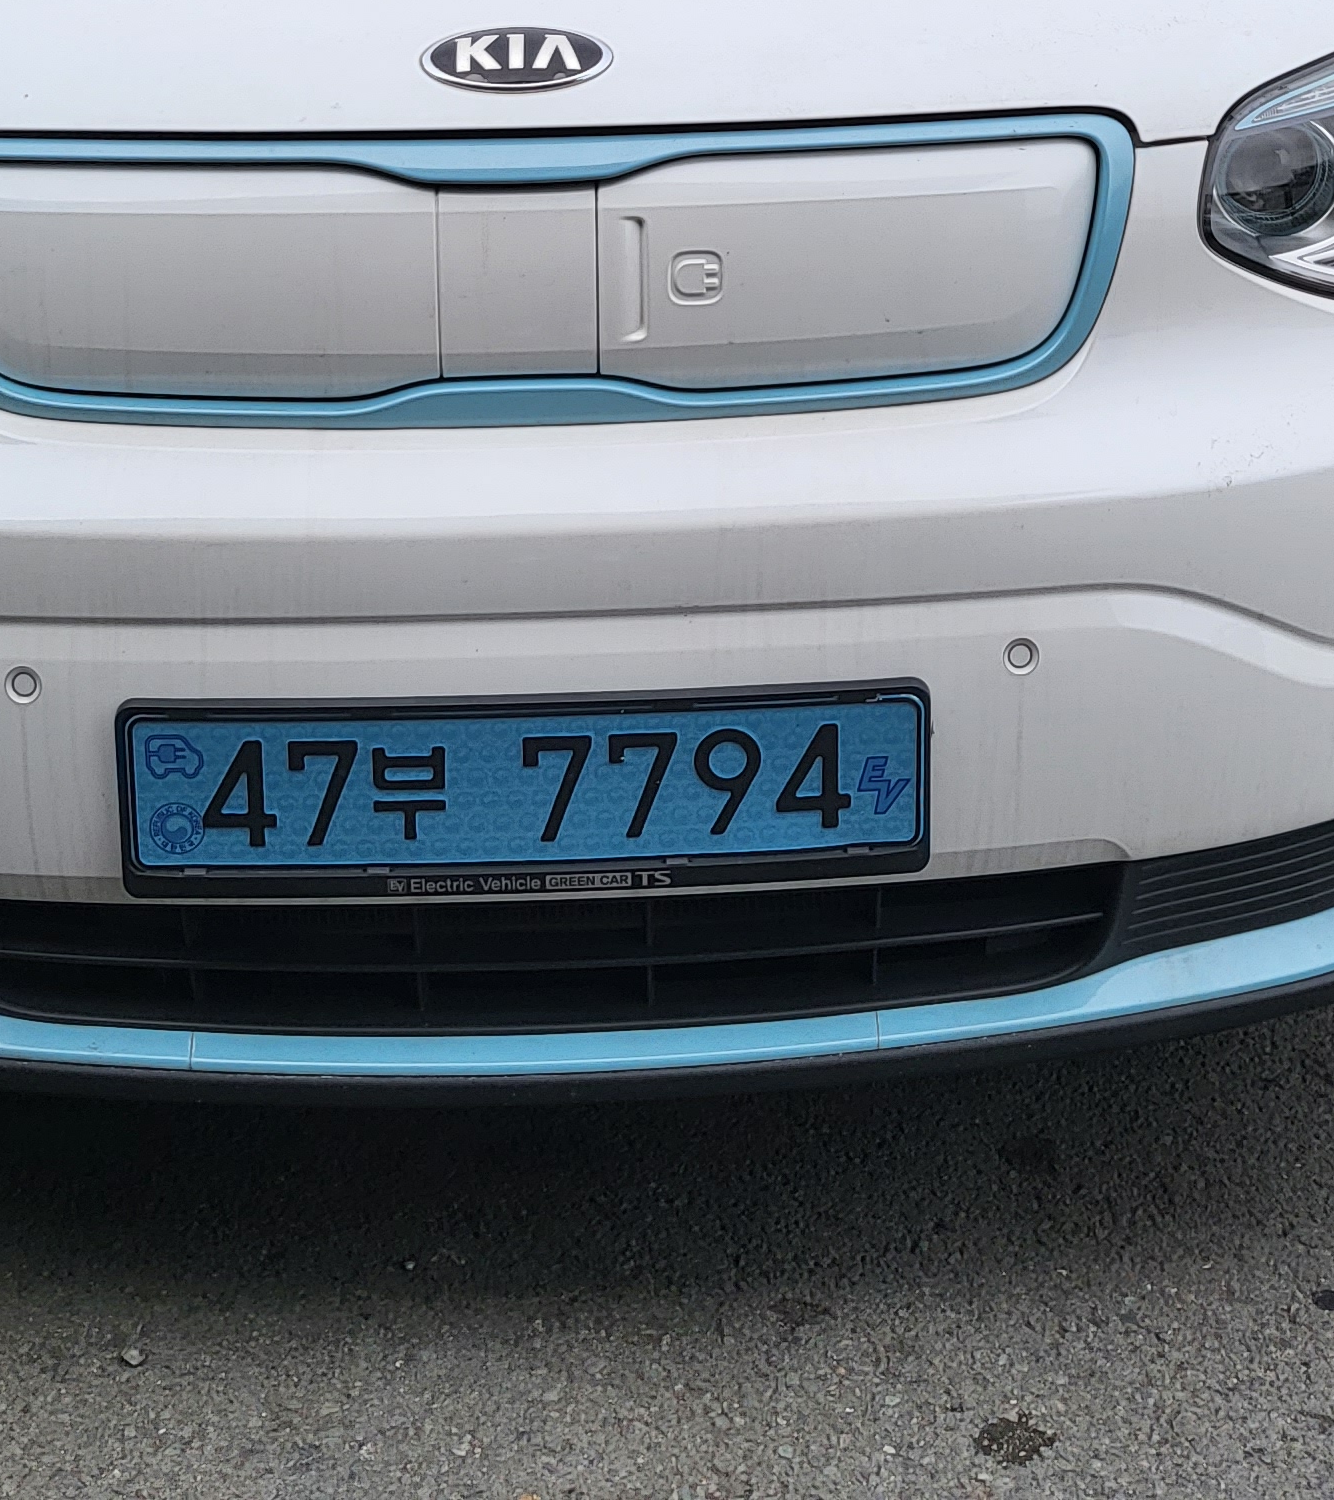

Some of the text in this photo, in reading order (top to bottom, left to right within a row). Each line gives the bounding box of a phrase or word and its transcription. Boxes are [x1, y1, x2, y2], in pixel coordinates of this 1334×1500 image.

[454, 33, 582, 73] KIA
[202, 723, 851, 847] 47부 7794
[857, 756, 912, 815] EV
[410, 877, 475, 893] Electric
[478, 875, 541, 893] Vehicle
[548, 875, 595, 888] GREEN
[599, 874, 630, 887] CAR
[635, 870, 672, 887] TS
